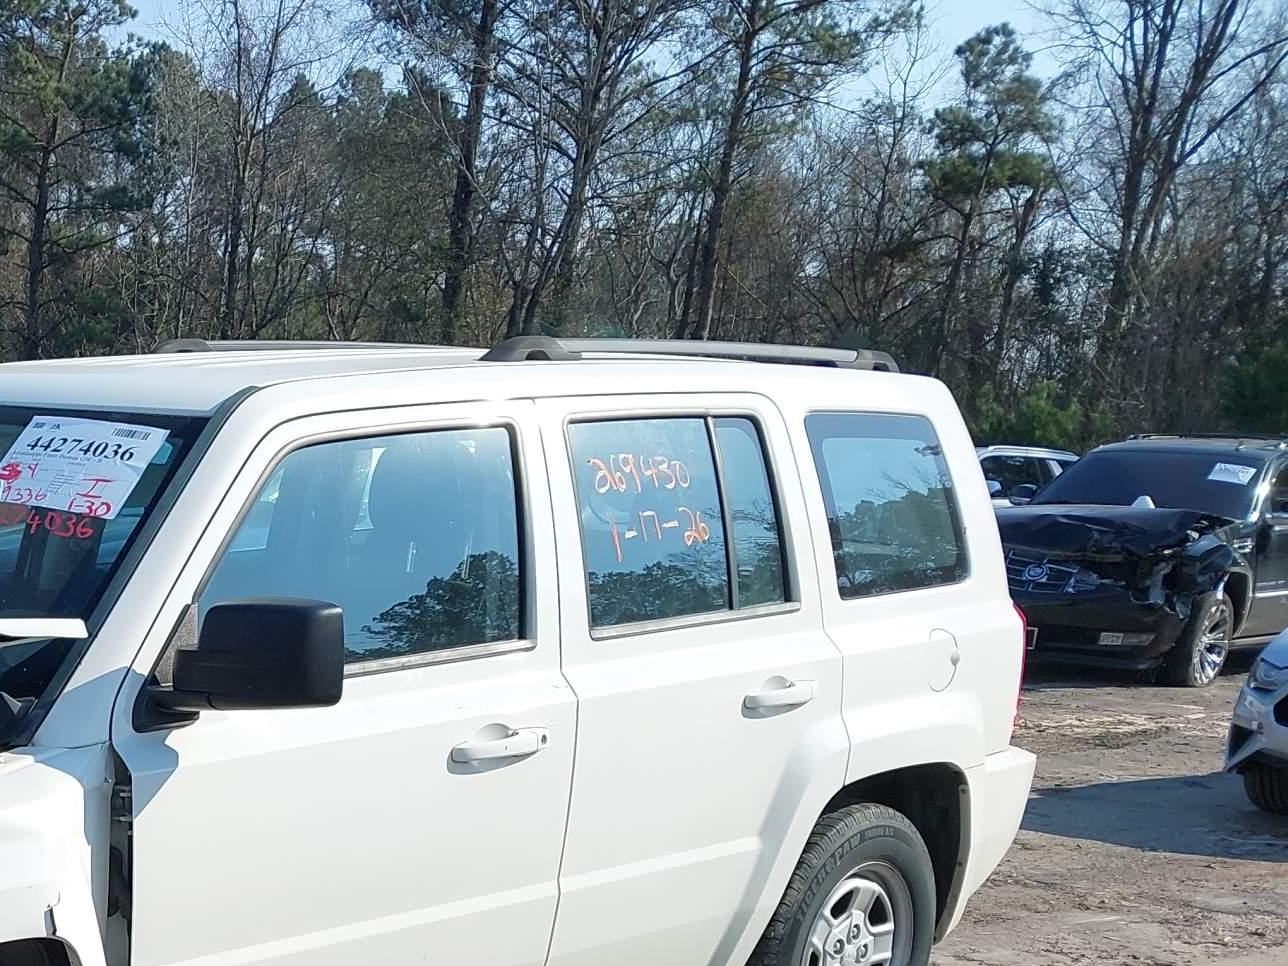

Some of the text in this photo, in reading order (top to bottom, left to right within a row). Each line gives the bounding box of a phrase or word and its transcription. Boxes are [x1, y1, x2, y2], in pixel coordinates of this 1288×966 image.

[26, 434, 140, 462] 44274036
[587, 453, 691, 494] 269430
[67, 498, 112, 518] 1-30
[607, 507, 710, 563] 1-17-26
[833, 832, 861, 866] PAW
